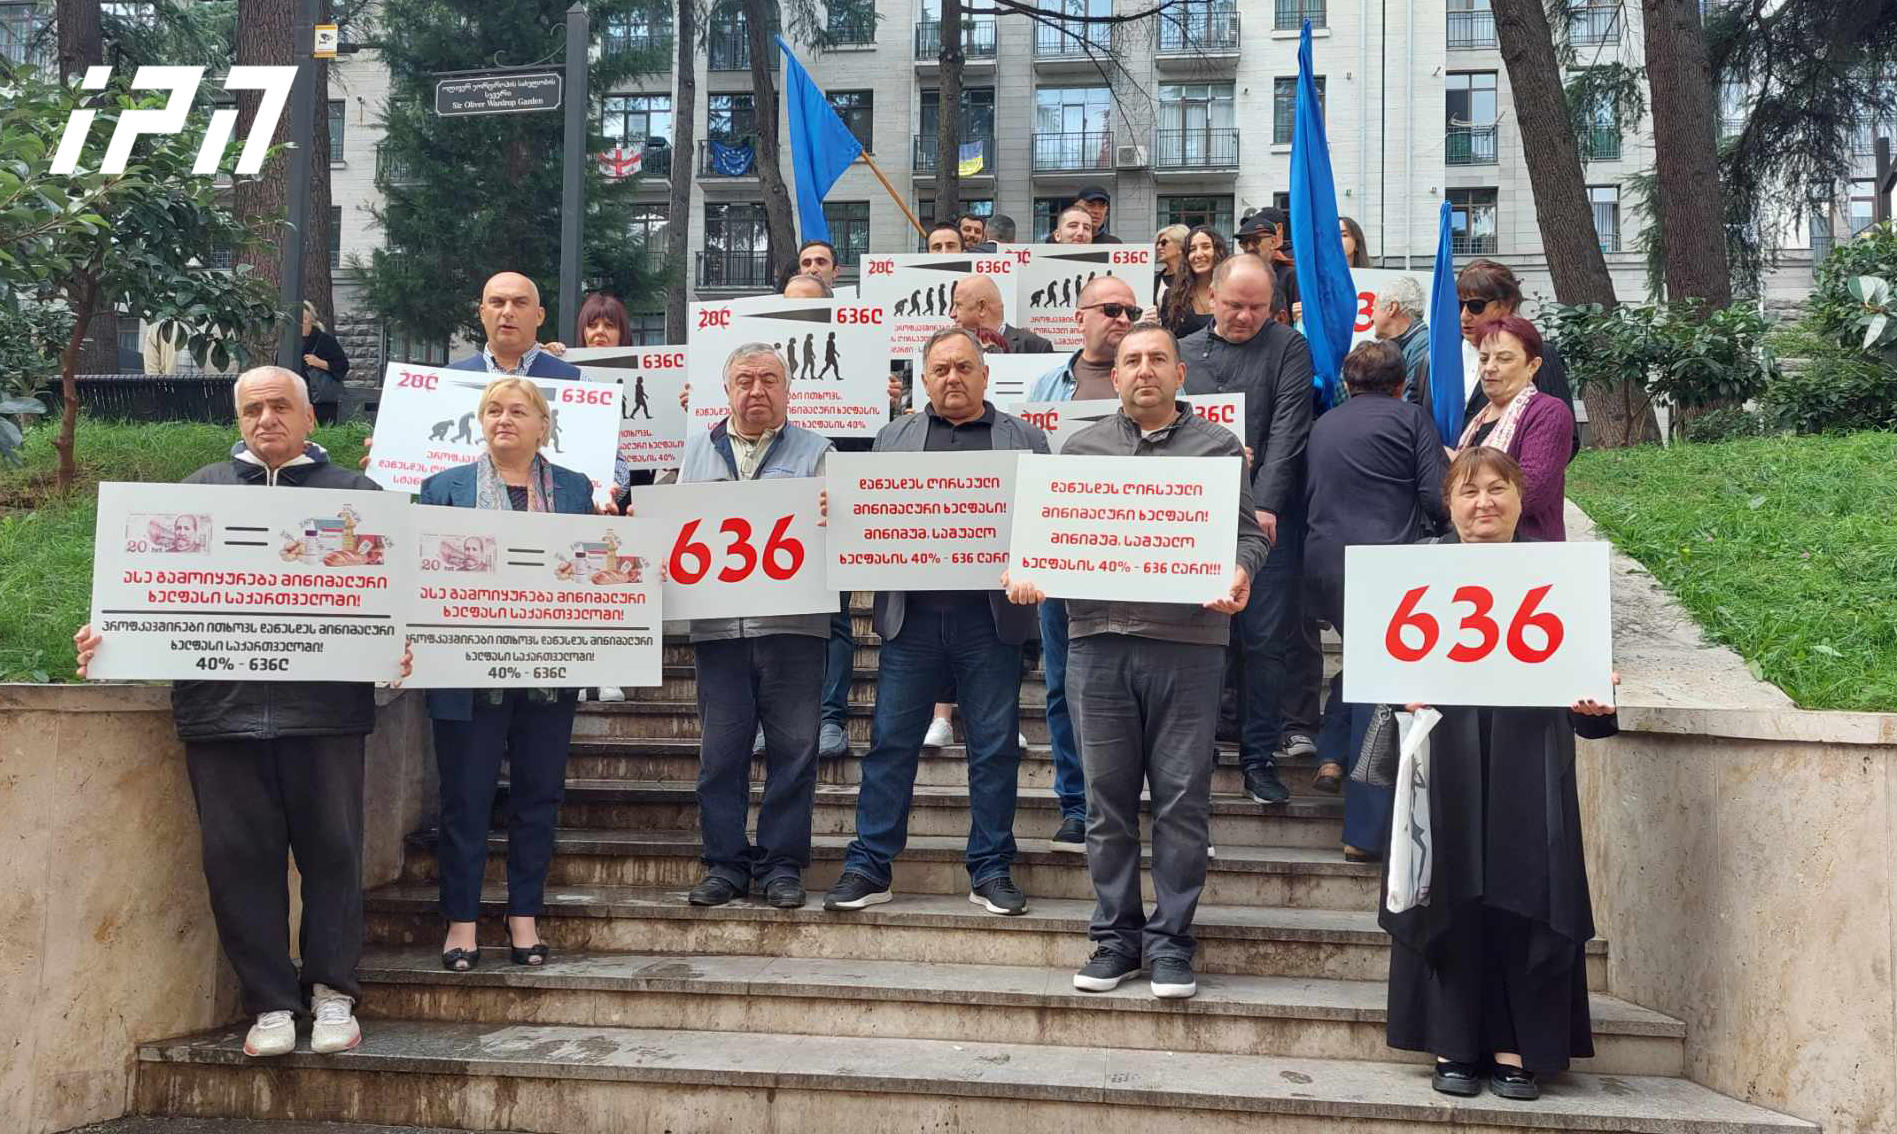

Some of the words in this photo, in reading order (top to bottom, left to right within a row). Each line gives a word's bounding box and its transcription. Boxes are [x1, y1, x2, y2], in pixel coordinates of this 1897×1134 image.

[486, 98, 516, 107] Wardrop
[518, 97, 544, 105] Garden
[859, 478, 924, 490] დაწესდეს
[1050, 481, 1119, 494] დაწესდეს
[853, 503, 941, 515] მინიმალური
[943, 502, 1007, 514] ხელფასი!
[1041, 507, 1135, 521] მინიმალური
[1138, 510, 1209, 523] ხელფასი!
[932, 527, 997, 539] საშუალო
[669, 513, 805, 585] 636
[1124, 535, 1195, 549] საშუალო
[839, 553, 908, 565] ხელფასის
[911, 552, 941, 565] 40%
[951, 552, 974, 564] 636
[1022, 557, 1094, 571] ხელფასის
[1098, 560, 1131, 573] 40%
[1143, 561, 1168, 574] 636
[1171, 563, 1221, 575] ლარი!!!
[123, 571, 151, 584] ასე
[157, 572, 277, 587] გამოიყურება
[281, 574, 387, 589] მინიმალური
[148, 590, 221, 604] ხელფასი
[225, 592, 361, 607] საქართველოში!
[420, 588, 446, 600] ასე
[450, 588, 553, 602] გამოიყურება
[557, 591, 646, 605] მინიმალური
[443, 606, 507, 619] ხელფასი
[510, 607, 624, 621] საქართველოში!
[102, 621, 204, 633] პროფკავშირები
[207, 621, 257, 633] ითხოვს
[260, 623, 316, 635] დაწესდეს
[319, 624, 395, 636] მინიმალური
[1385, 583, 1565, 664] 636
[171, 640, 223, 651] ხელფასი
[226, 641, 323, 653] საქართველოში!
[495, 634, 539, 646] ითხოვს
[541, 635, 588, 646] დაწესდეს
[590, 636, 653, 646] მინიმალური
[465, 651, 511, 662] ხელფასი
[512, 652, 595, 662] საქართველოში!
[196, 657, 235, 671] 40%
[488, 666, 521, 679] 40%
